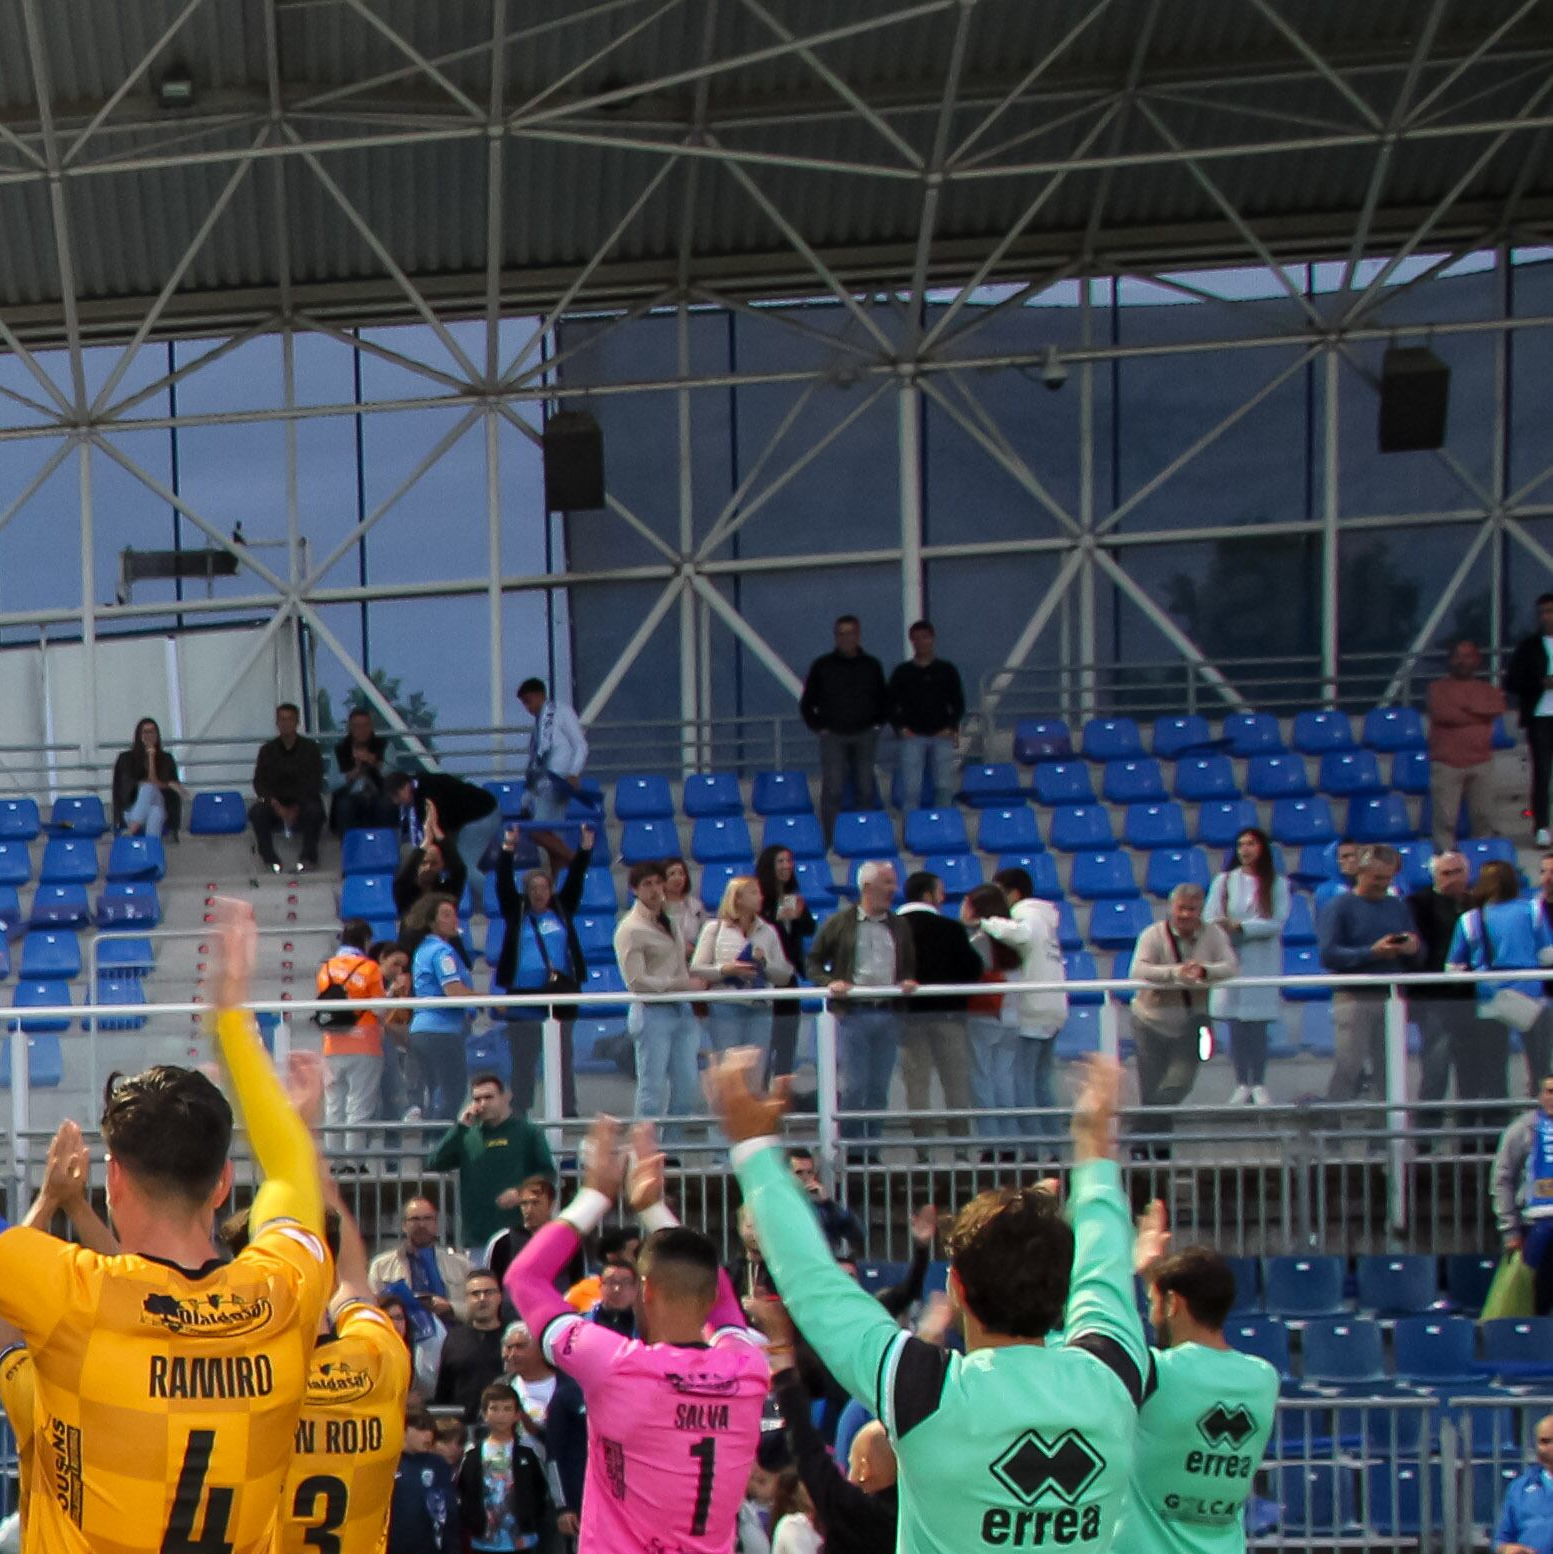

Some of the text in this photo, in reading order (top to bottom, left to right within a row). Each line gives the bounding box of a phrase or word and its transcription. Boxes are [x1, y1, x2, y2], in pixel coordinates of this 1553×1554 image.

[149, 1354, 273, 1399] RAMIRO
[325, 1416, 383, 1455] ROJO
[674, 1403, 729, 1431] SALVA
[689, 1436, 716, 1537] 1
